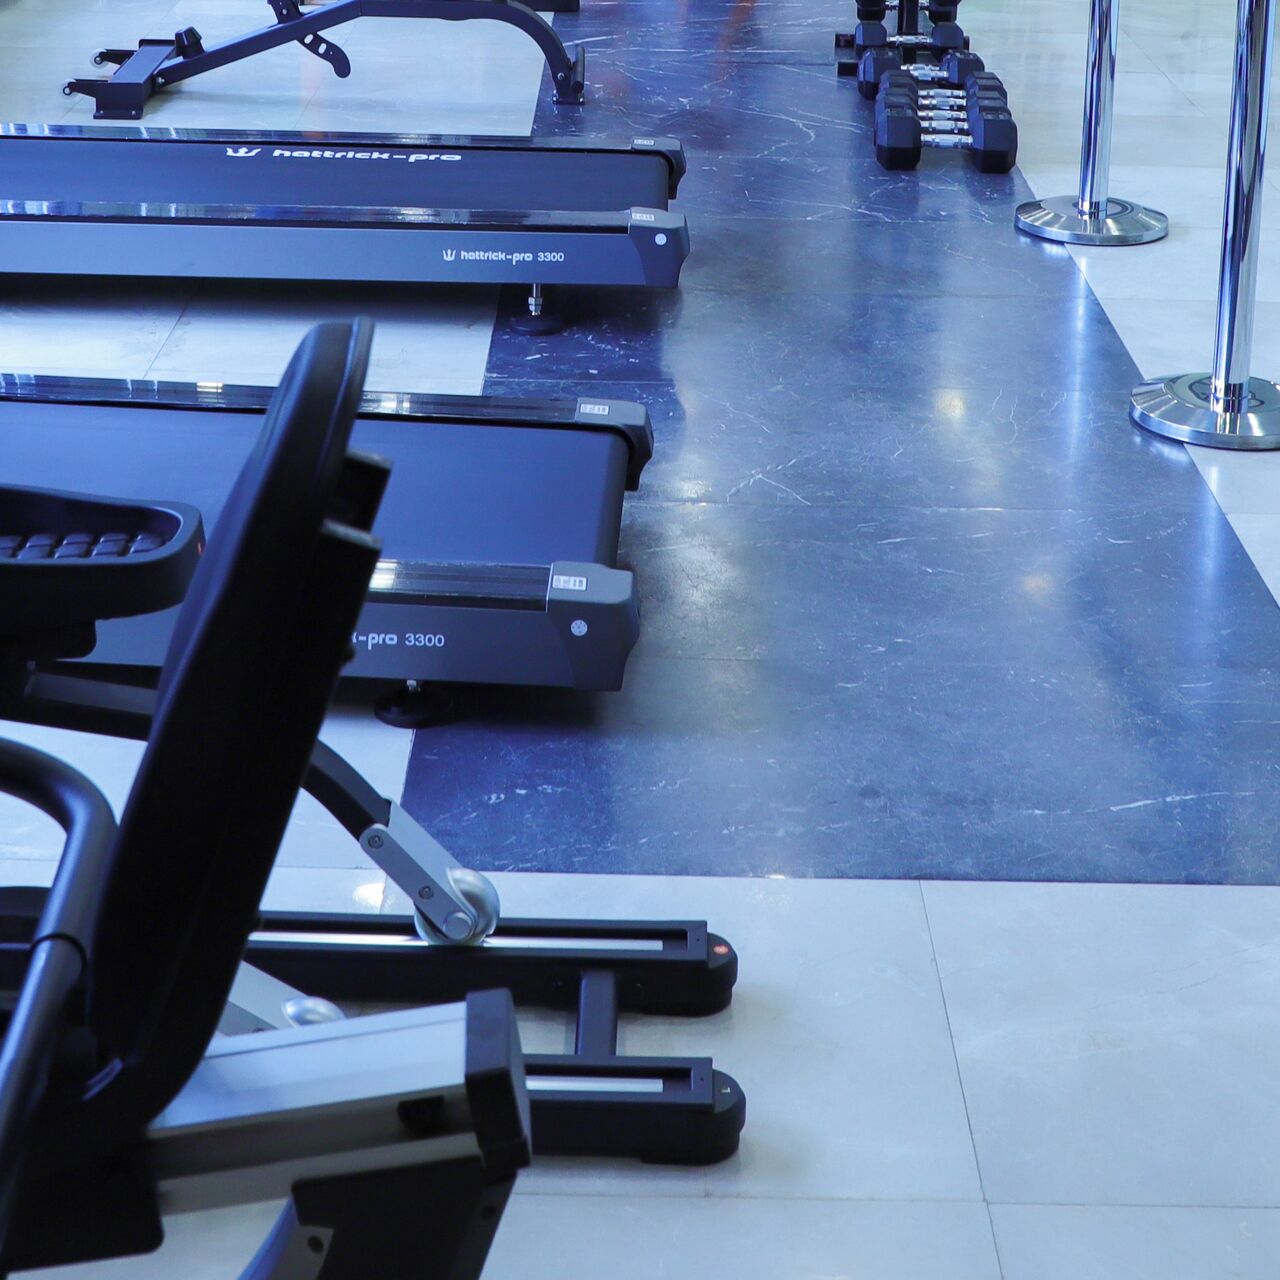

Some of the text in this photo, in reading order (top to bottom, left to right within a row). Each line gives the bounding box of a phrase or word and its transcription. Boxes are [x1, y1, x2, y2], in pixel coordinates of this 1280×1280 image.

[273, 149, 462, 163] hattrick-pro
[460, 250, 564, 265] hattrick-pro 3300
[404, 633, 445, 647] 3300
